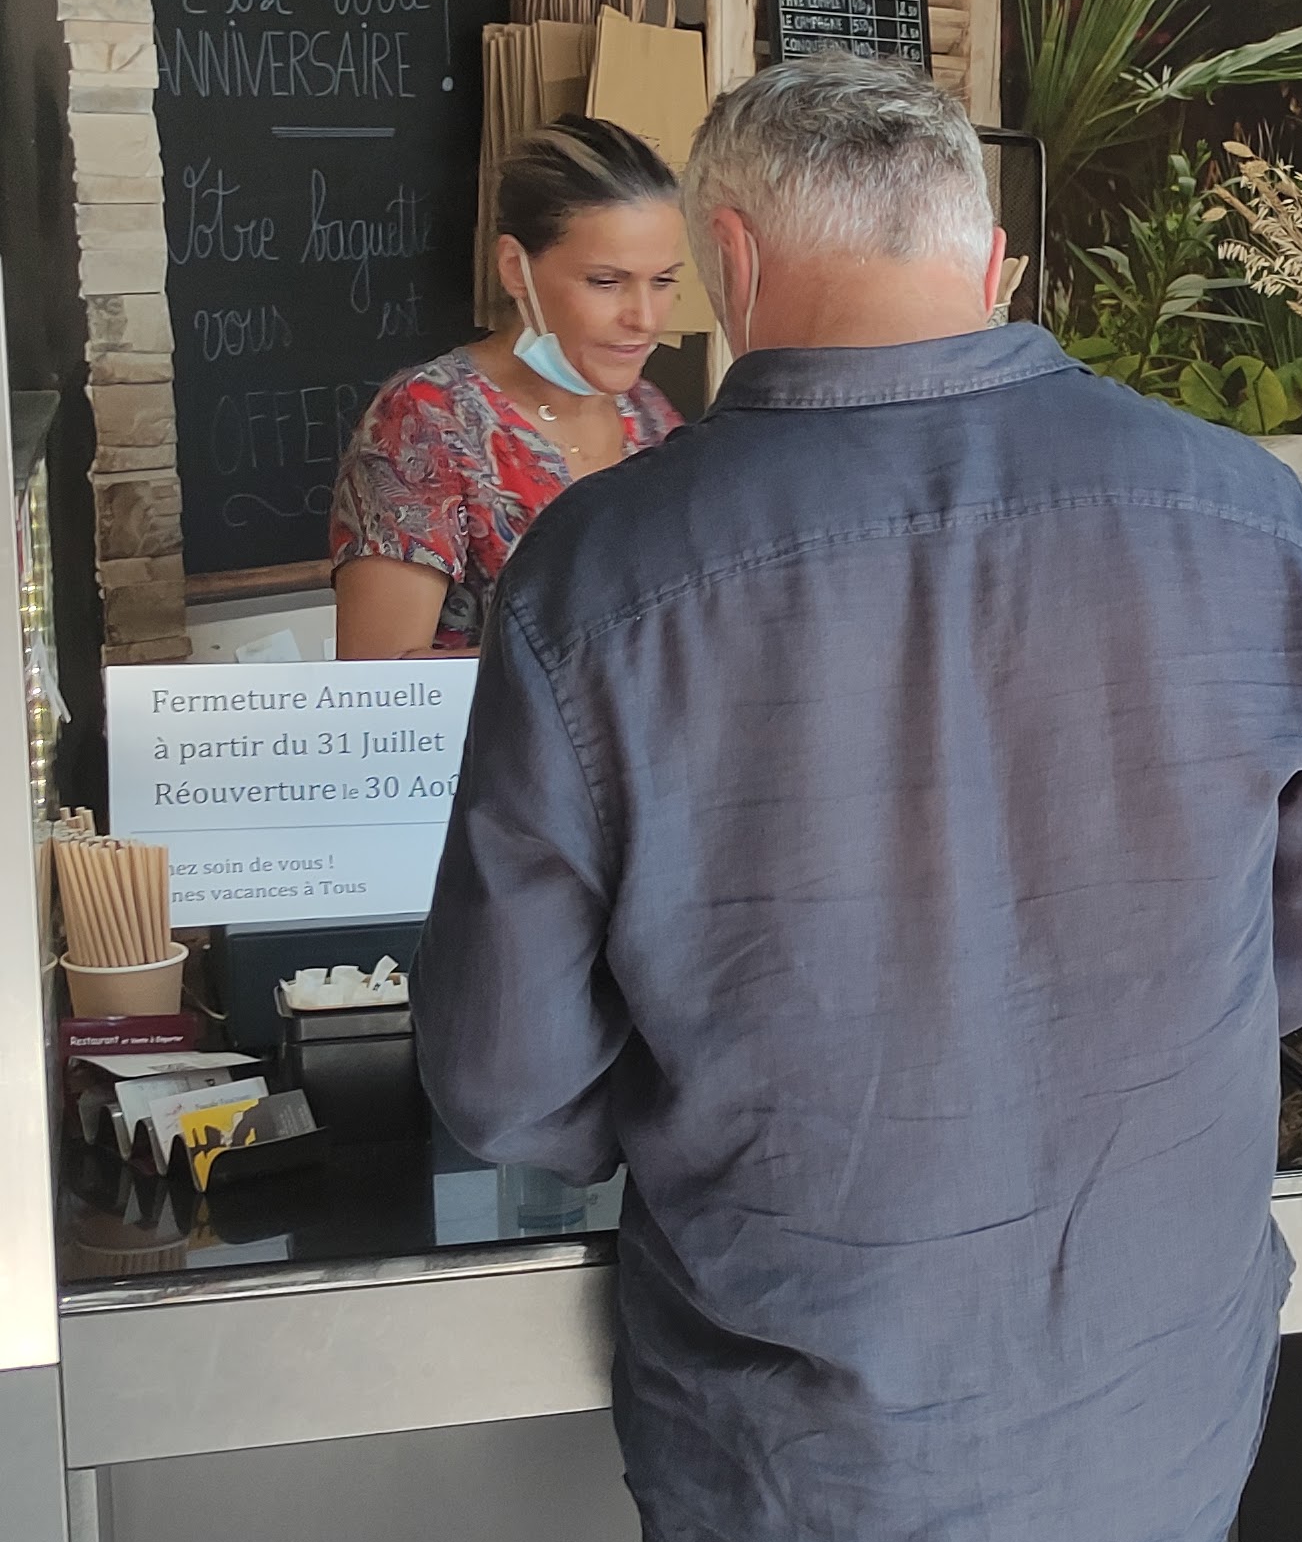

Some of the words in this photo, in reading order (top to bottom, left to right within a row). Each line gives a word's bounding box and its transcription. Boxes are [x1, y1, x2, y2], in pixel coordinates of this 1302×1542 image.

[168, 157, 279, 265] Votre
[301, 169, 432, 312] baguette
[194, 304, 293, 360] vous
[152, 688, 308, 714] Fermeture
[316, 682, 443, 709] Annuelle
[154, 736, 170, 760] à
[179, 735, 265, 766] partir
[272, 732, 308, 757] du
[317, 731, 352, 756] 31
[361, 729, 446, 759] Juillet
[155, 780, 336, 807] Réouverture
[342, 783, 360, 800] le
[364, 775, 399, 800] 30
[203, 858, 243, 875] soin
[249, 857, 273, 873] de
[278, 857, 323, 872] vous
[210, 884, 299, 902] vacances
[303, 879, 314, 896] à
[319, 880, 367, 895] Tous
